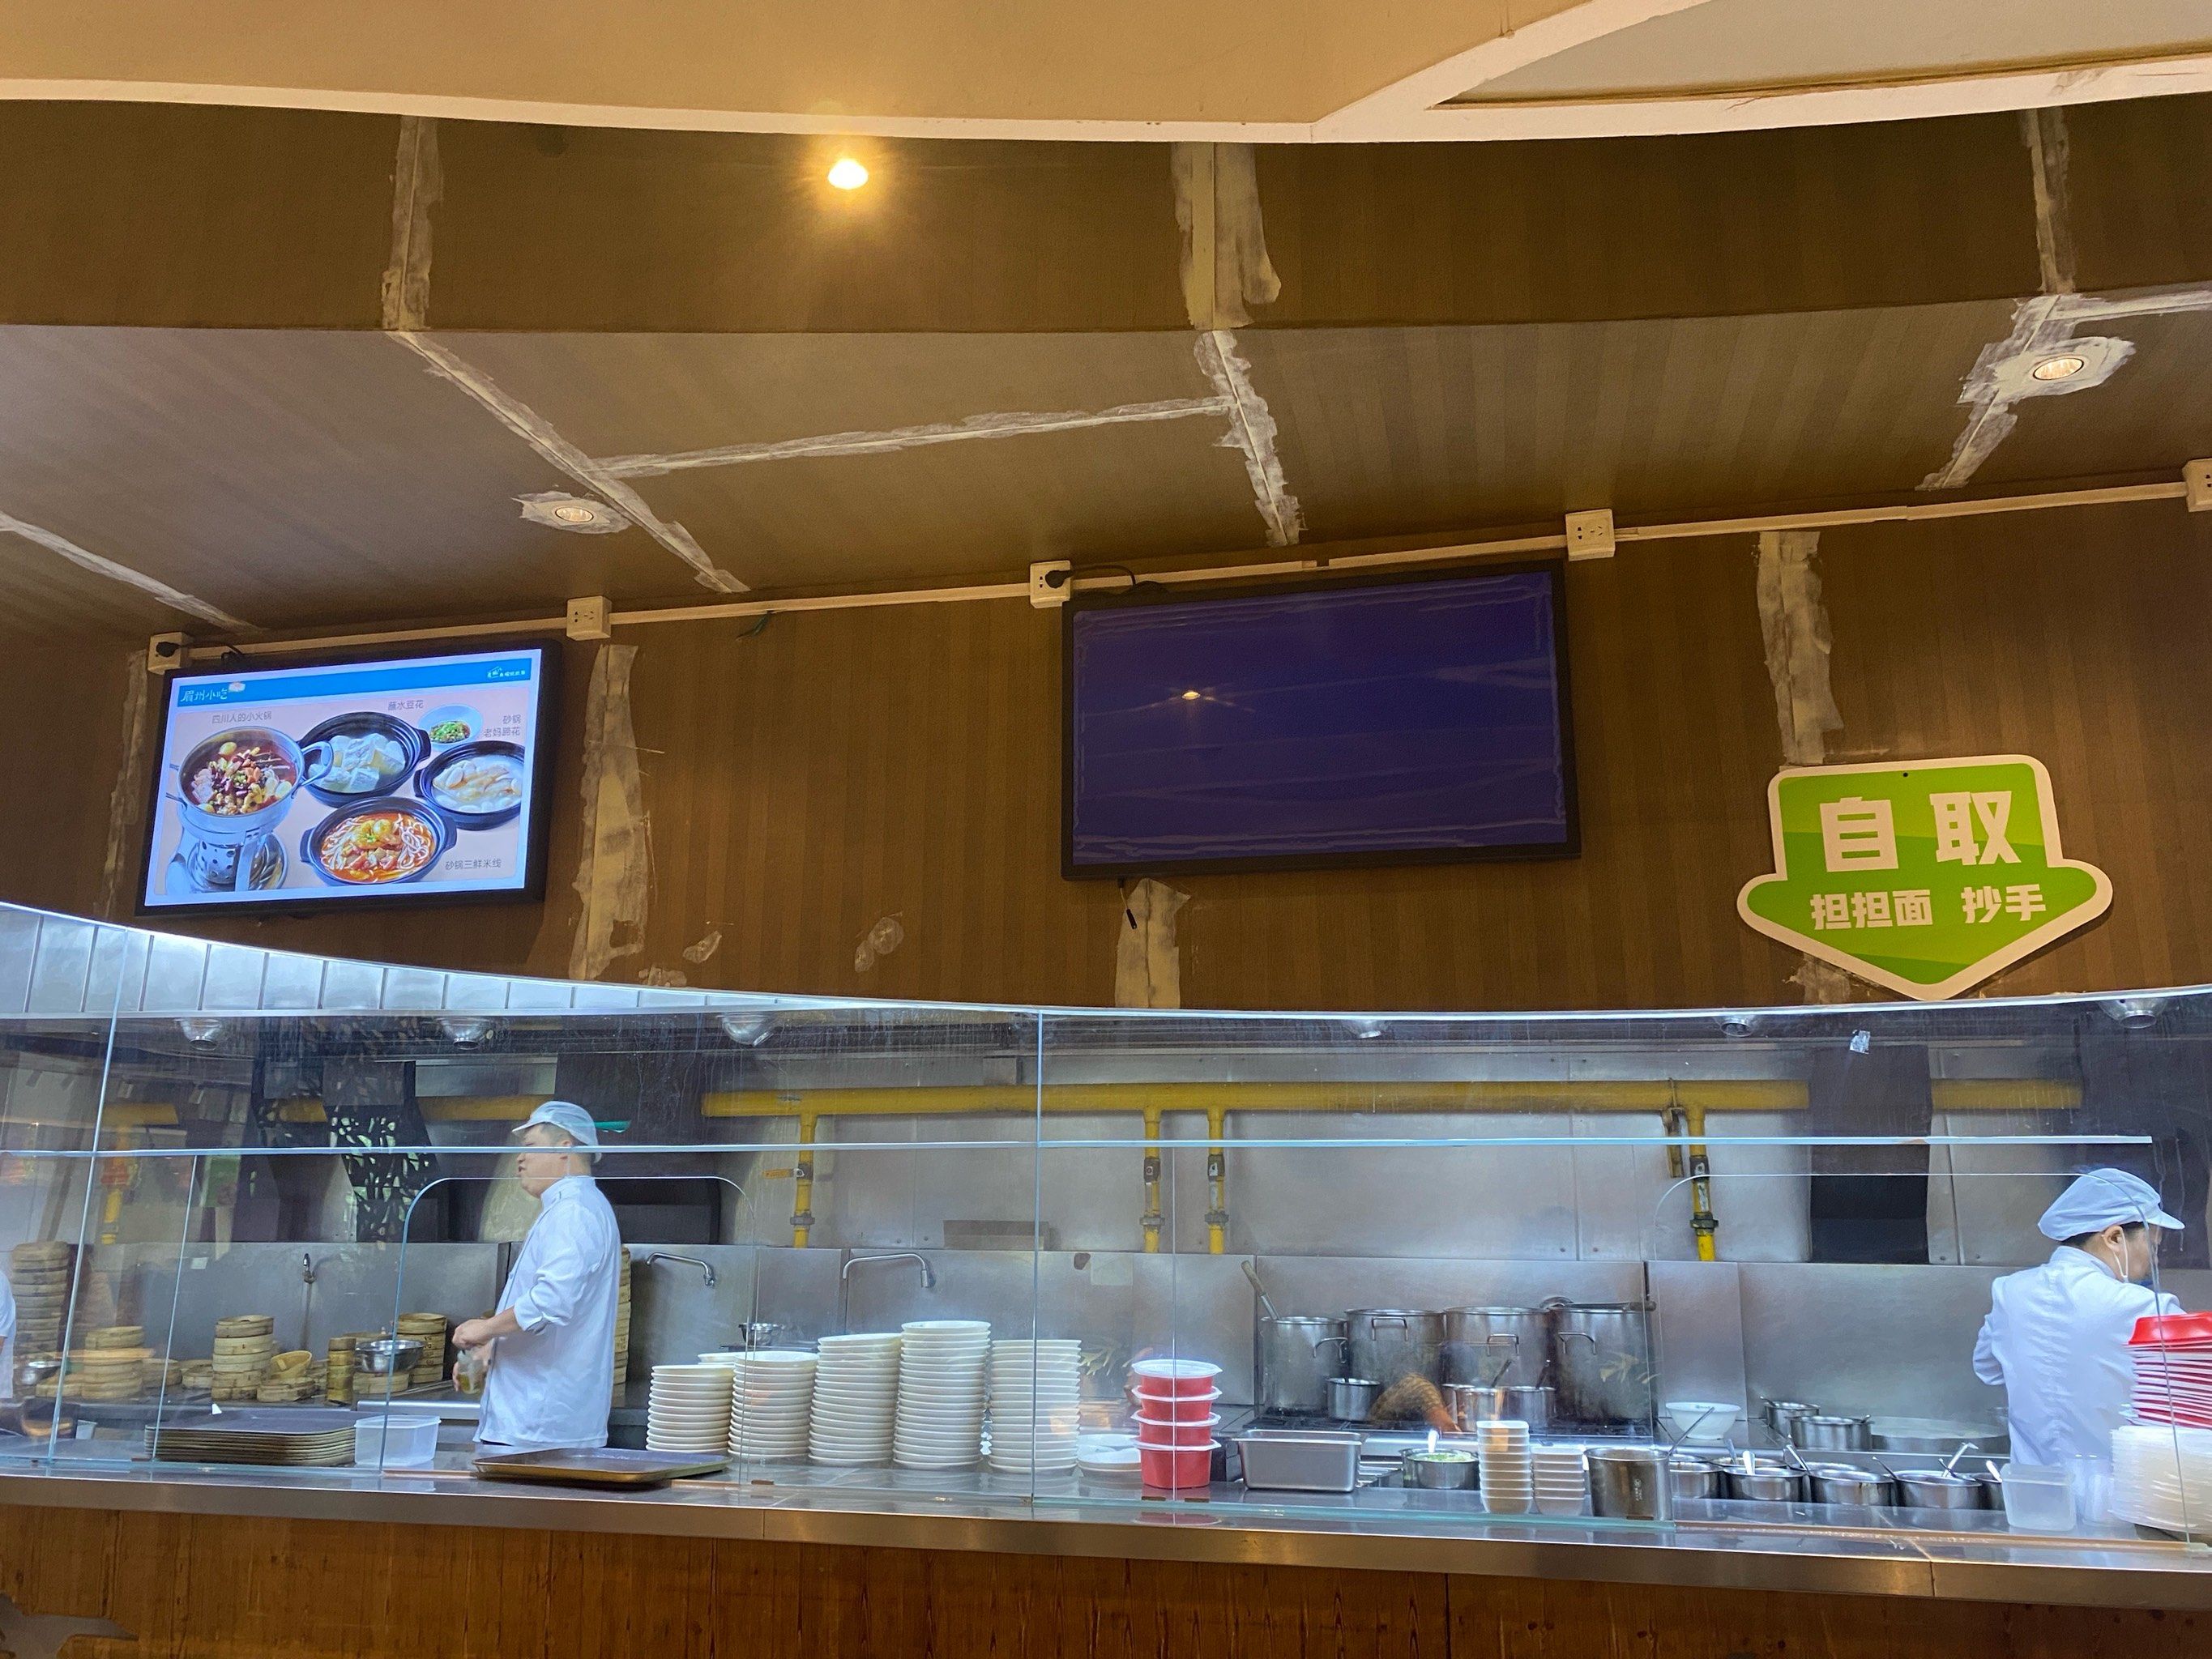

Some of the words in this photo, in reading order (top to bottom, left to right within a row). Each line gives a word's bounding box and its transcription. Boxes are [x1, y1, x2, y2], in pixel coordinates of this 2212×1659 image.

[180, 688, 228, 702] 眉州小吃
[211, 710, 272, 724] 四川人的小火锅
[502, 714, 522, 725] 砂锅
[483, 726, 520, 738] 老妈蹄花
[445, 859, 502, 871] 砂锅三鲜米线
[1810, 889, 1932, 930] 担担面
[1961, 884, 2047, 925] 抄手
